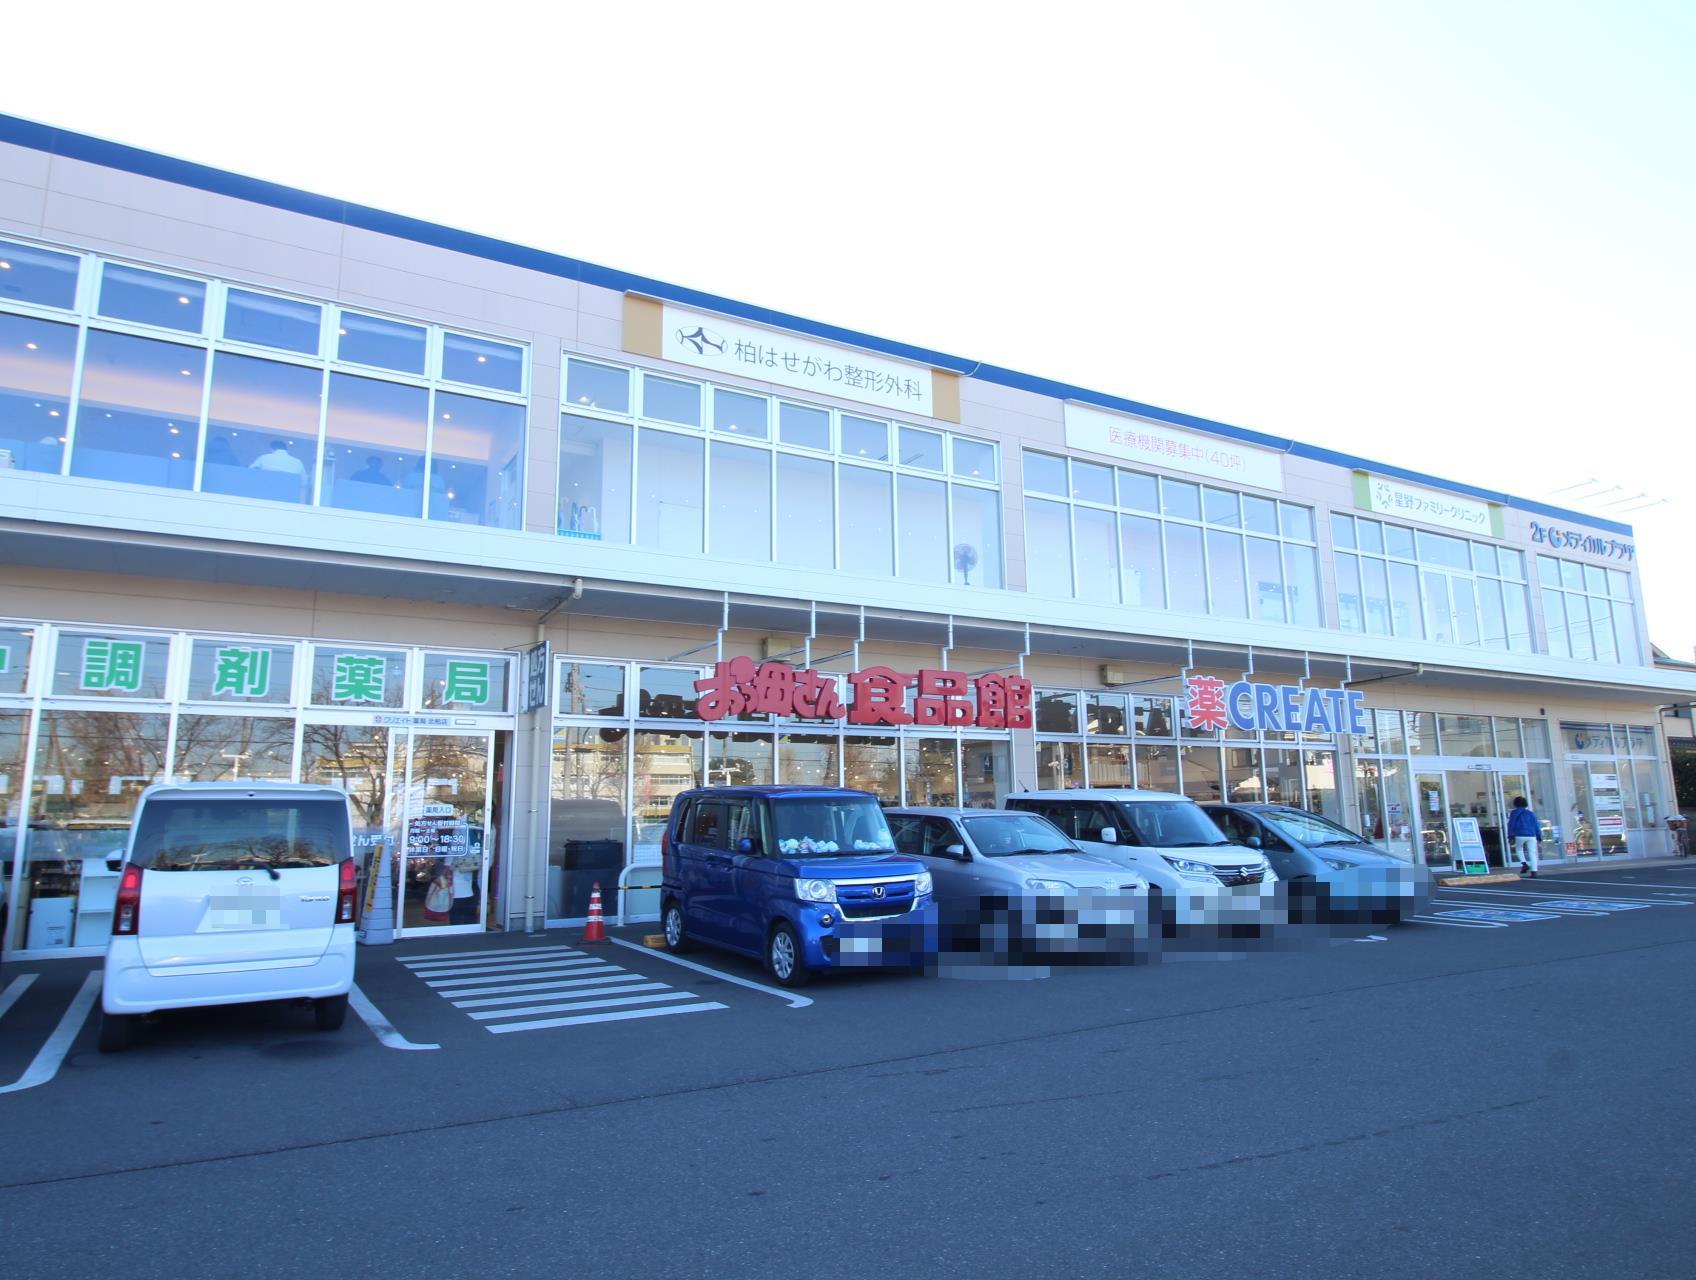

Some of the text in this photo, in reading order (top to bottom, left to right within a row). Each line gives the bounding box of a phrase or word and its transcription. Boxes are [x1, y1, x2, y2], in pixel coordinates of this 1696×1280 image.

[734, 339, 922, 401] 柏はせがわ整形外科
